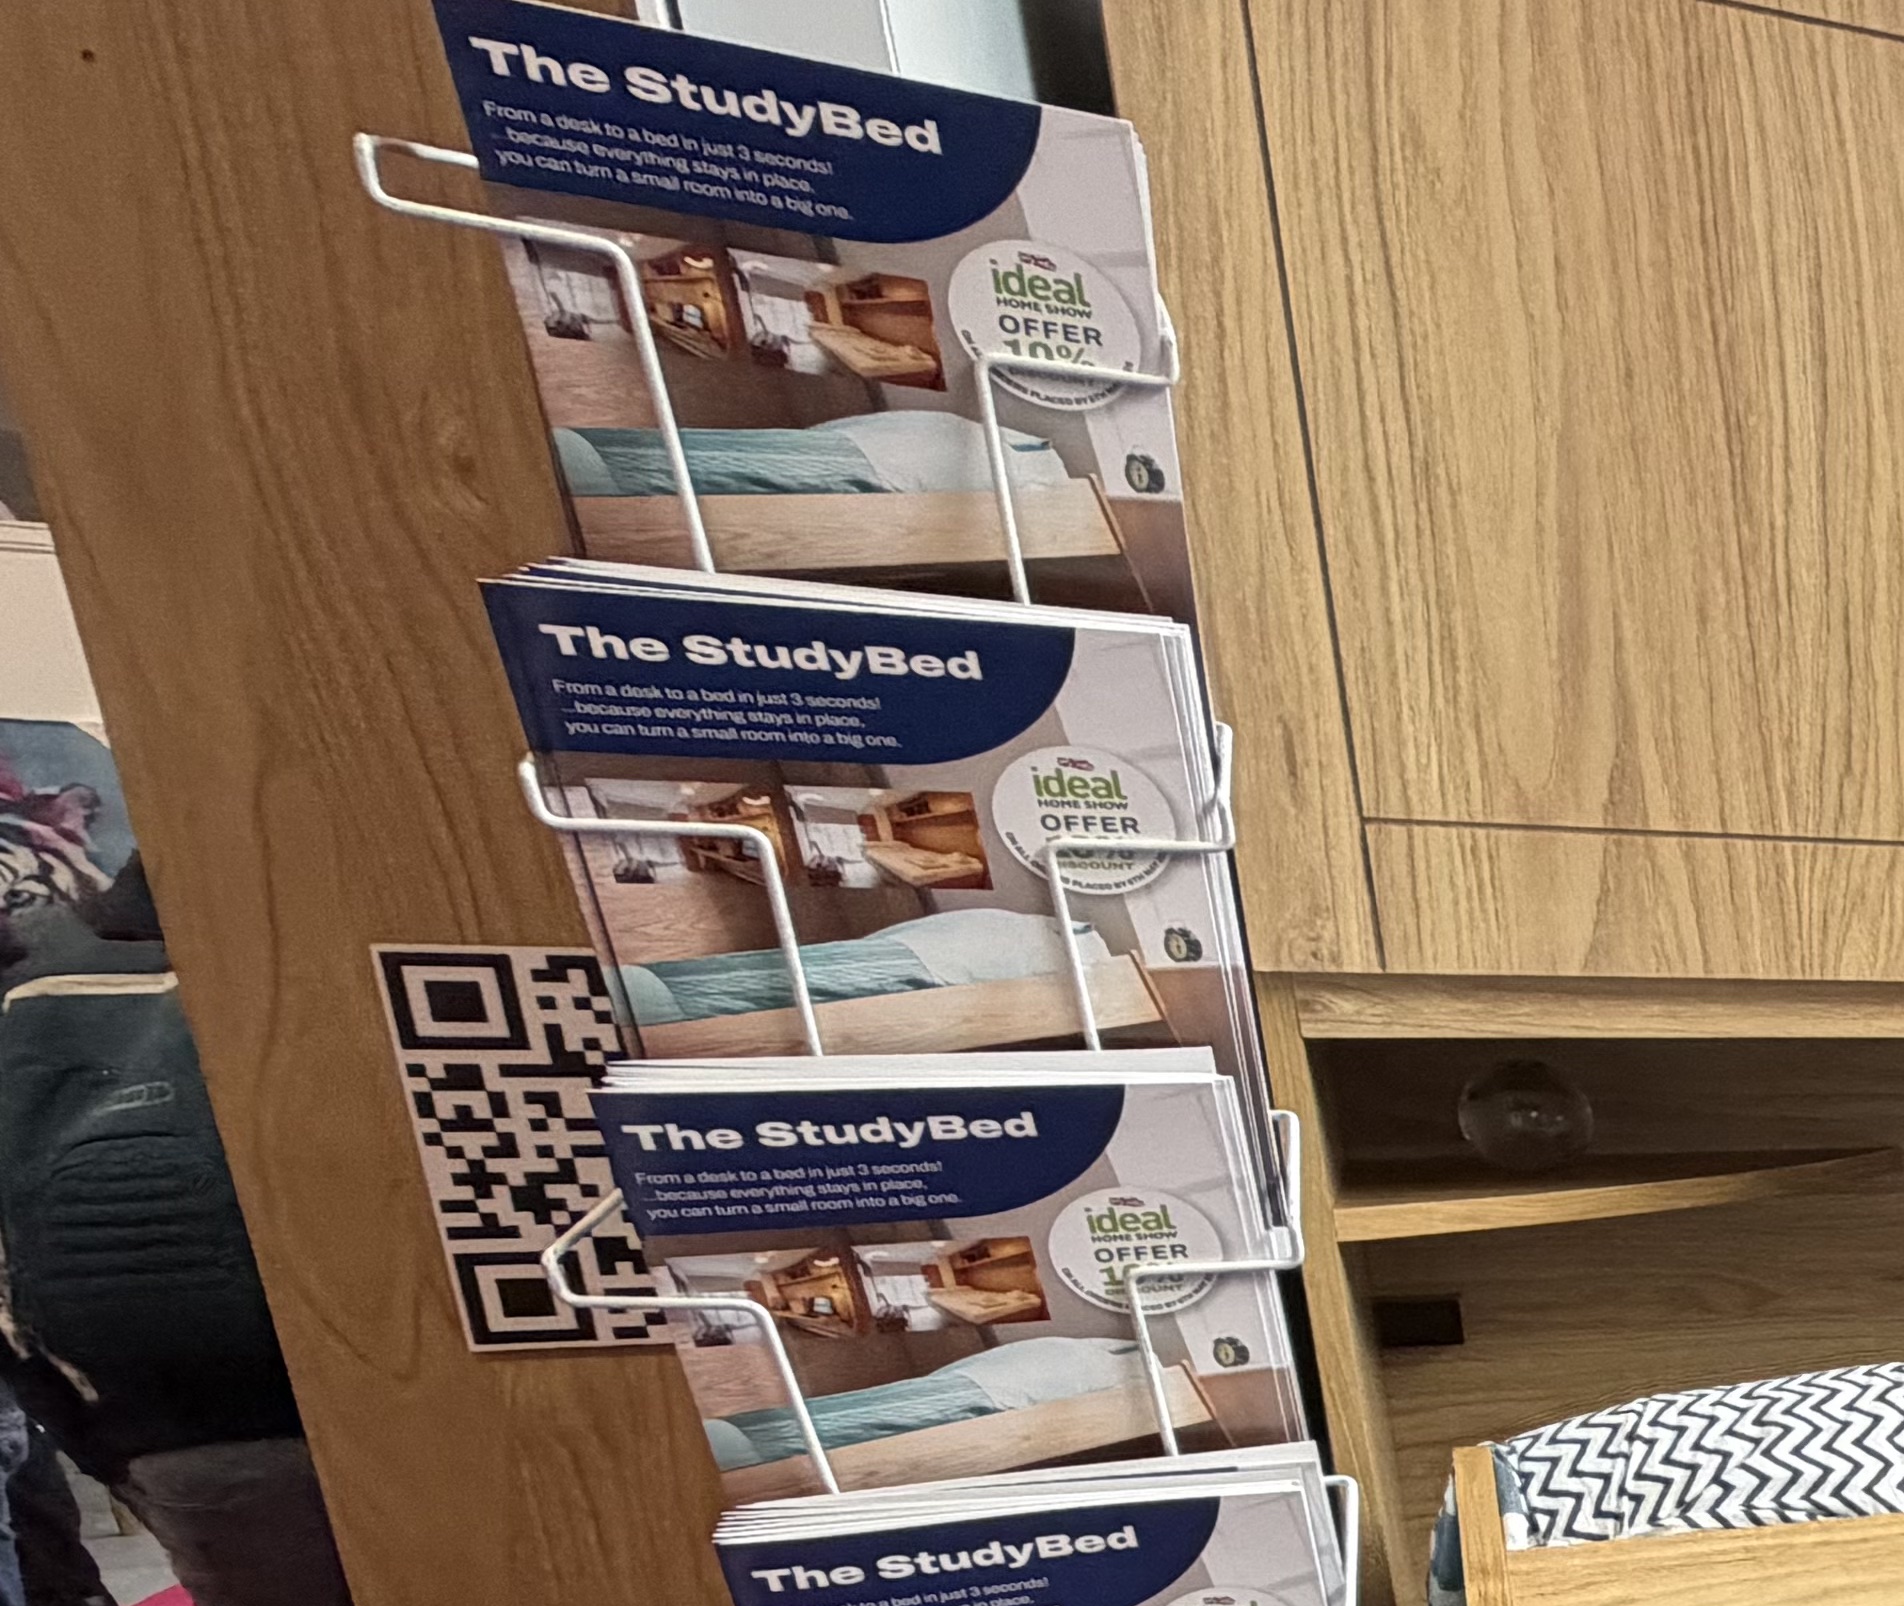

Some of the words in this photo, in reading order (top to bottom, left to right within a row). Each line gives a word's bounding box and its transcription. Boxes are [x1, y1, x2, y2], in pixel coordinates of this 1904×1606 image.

[468, 35, 610, 94] The
[623, 65, 943, 155] StudyBed
[989, 258, 1091, 308] ideal
[996, 296, 1042, 314] HOME
[1046, 304, 1093, 319] SHOW
[999, 313, 1103, 347] OFFER
[538, 624, 670, 662] The
[682, 634, 983, 680] StudyBed
[552, 679, 602, 695] From
[605, 684, 617, 696] a
[620, 684, 663, 698] desk
[664, 687, 684, 701] to
[687, 689, 700, 701] a
[701, 688, 735, 703] bed
[736, 690, 754, 704] in
[756, 690, 788, 707] just
[790, 693, 804, 706] 3
[807, 694, 881, 710] seconds!
[654, 707, 747, 725] everything
[748, 709, 794, 727] stays
[797, 710, 812, 725] in
[564, 720, 600, 735] you
[601, 722, 636, 736] can
[637, 723, 675, 738] turn
[677, 726, 690, 738] a
[691, 726, 739, 741] small
[740, 730, 787, 743] room
[788, 729, 820, 745] into
[822, 733, 835, 745] a
[837, 732, 864, 749] big
[1031, 765, 1128, 800] ideal
[1037, 799, 1080, 810] HOME
[1085, 800, 1128, 811] SHOW
[1040, 813, 1140, 834] OFFER
[620, 1123, 745, 1151] The
[755, 1111, 1039, 1148] StudyBed
[1084, 1204, 1177, 1234] ideal
[1091, 1232, 1133, 1243] HOME
[1135, 1231, 1178, 1241] SHOW
[1094, 1243, 1188, 1263] OFFER
[751, 1565, 865, 1592] The
[876, 1525, 1139, 1579] StudyBed
